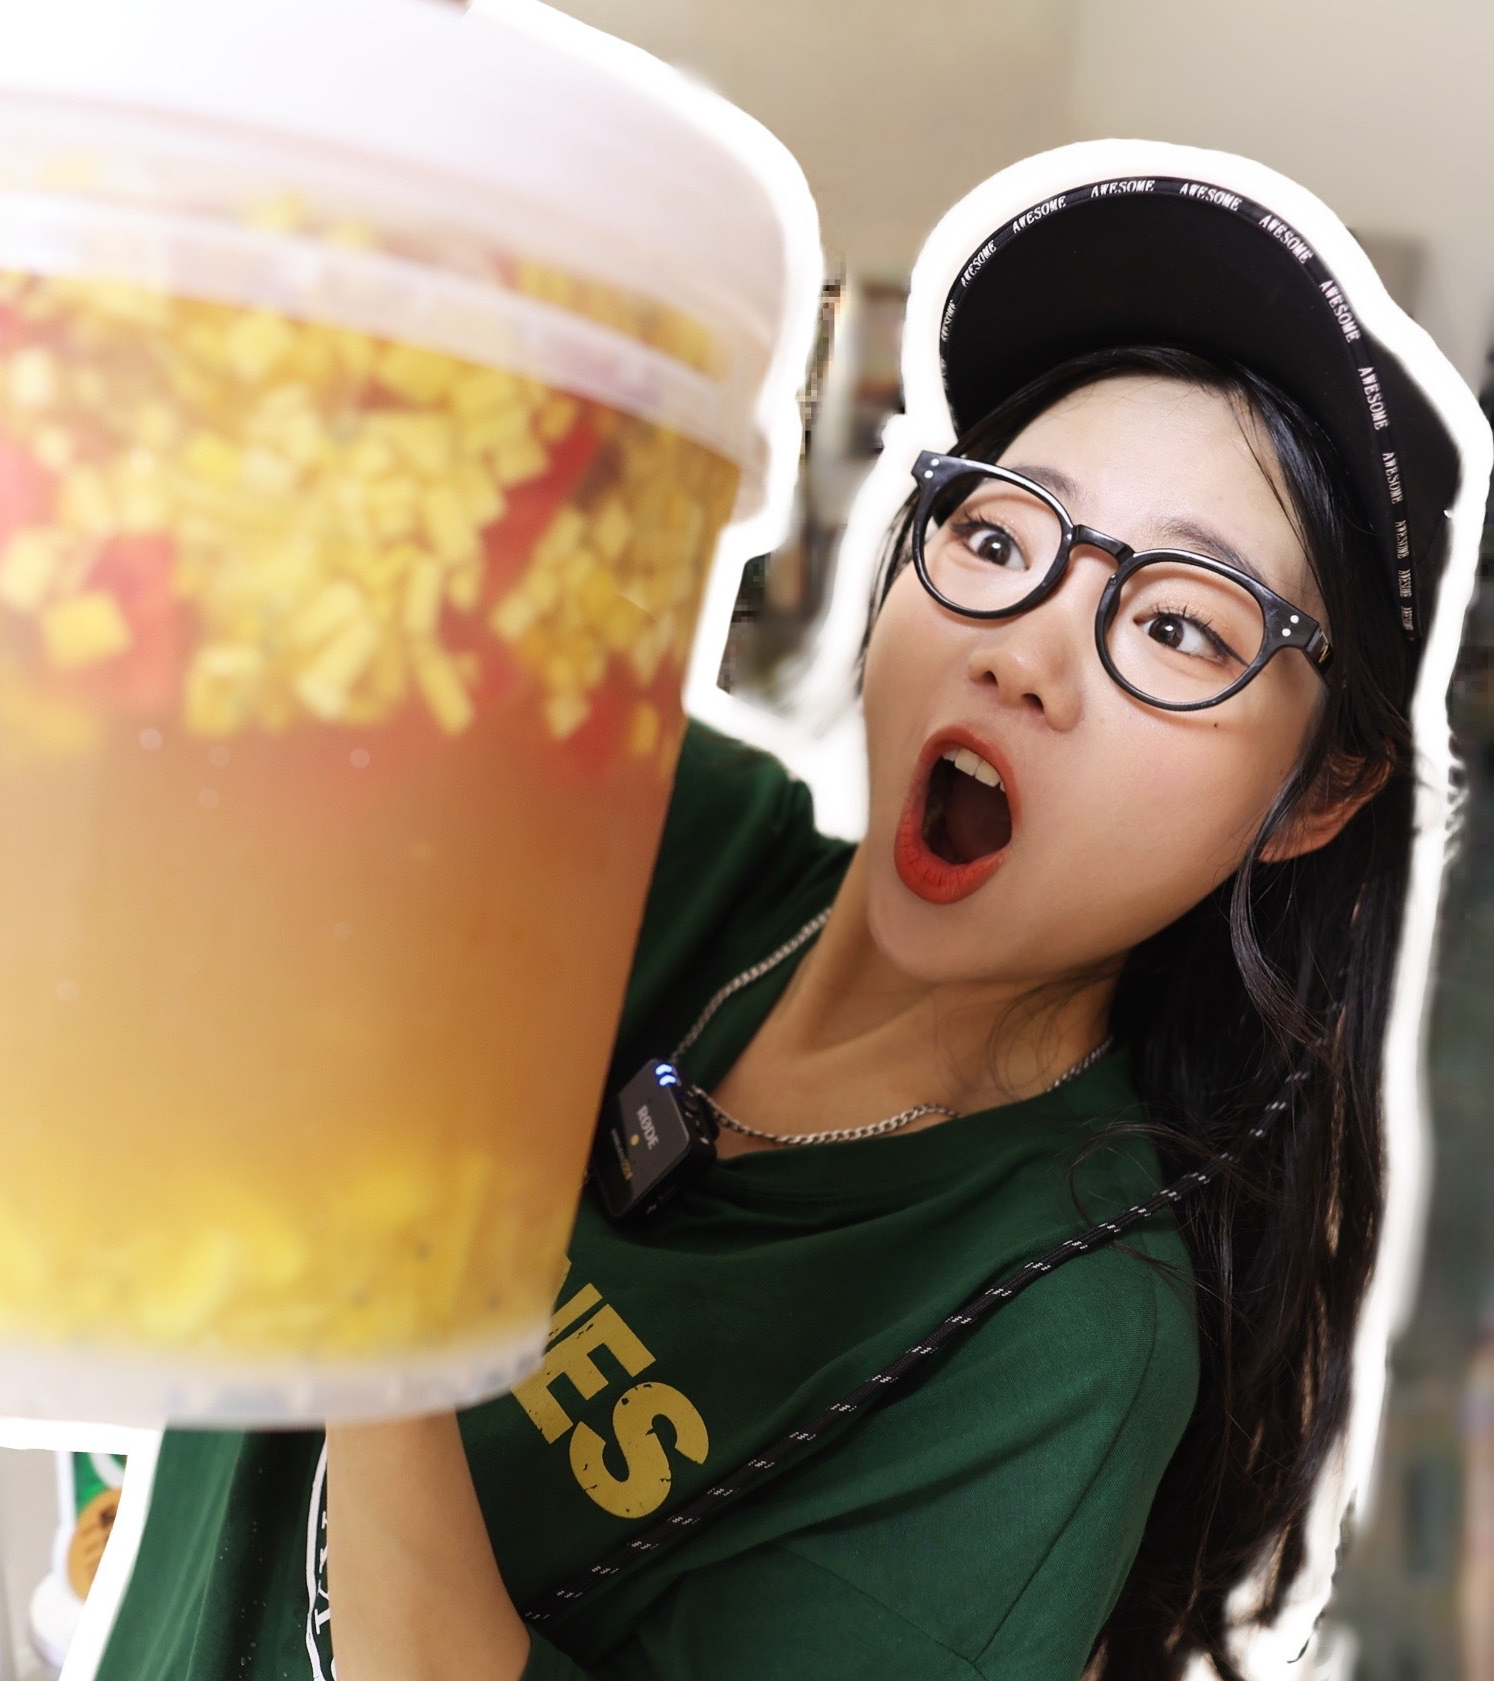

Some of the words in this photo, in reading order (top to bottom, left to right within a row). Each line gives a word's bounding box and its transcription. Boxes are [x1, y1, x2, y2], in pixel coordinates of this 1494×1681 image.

[960, 240, 997, 287] AWESOME
[1012, 195, 1066, 233] AWESOME
[1091, 179, 1156, 198] AWESOME
[1179, 183, 1243, 211] AWESOME
[1259, 215, 1314, 264] AWESOME
[1319, 280, 1362, 343] AWESOME
[1358, 366, 1390, 431] AWESOME
[1382, 452, 1404, 505] AWESOME
